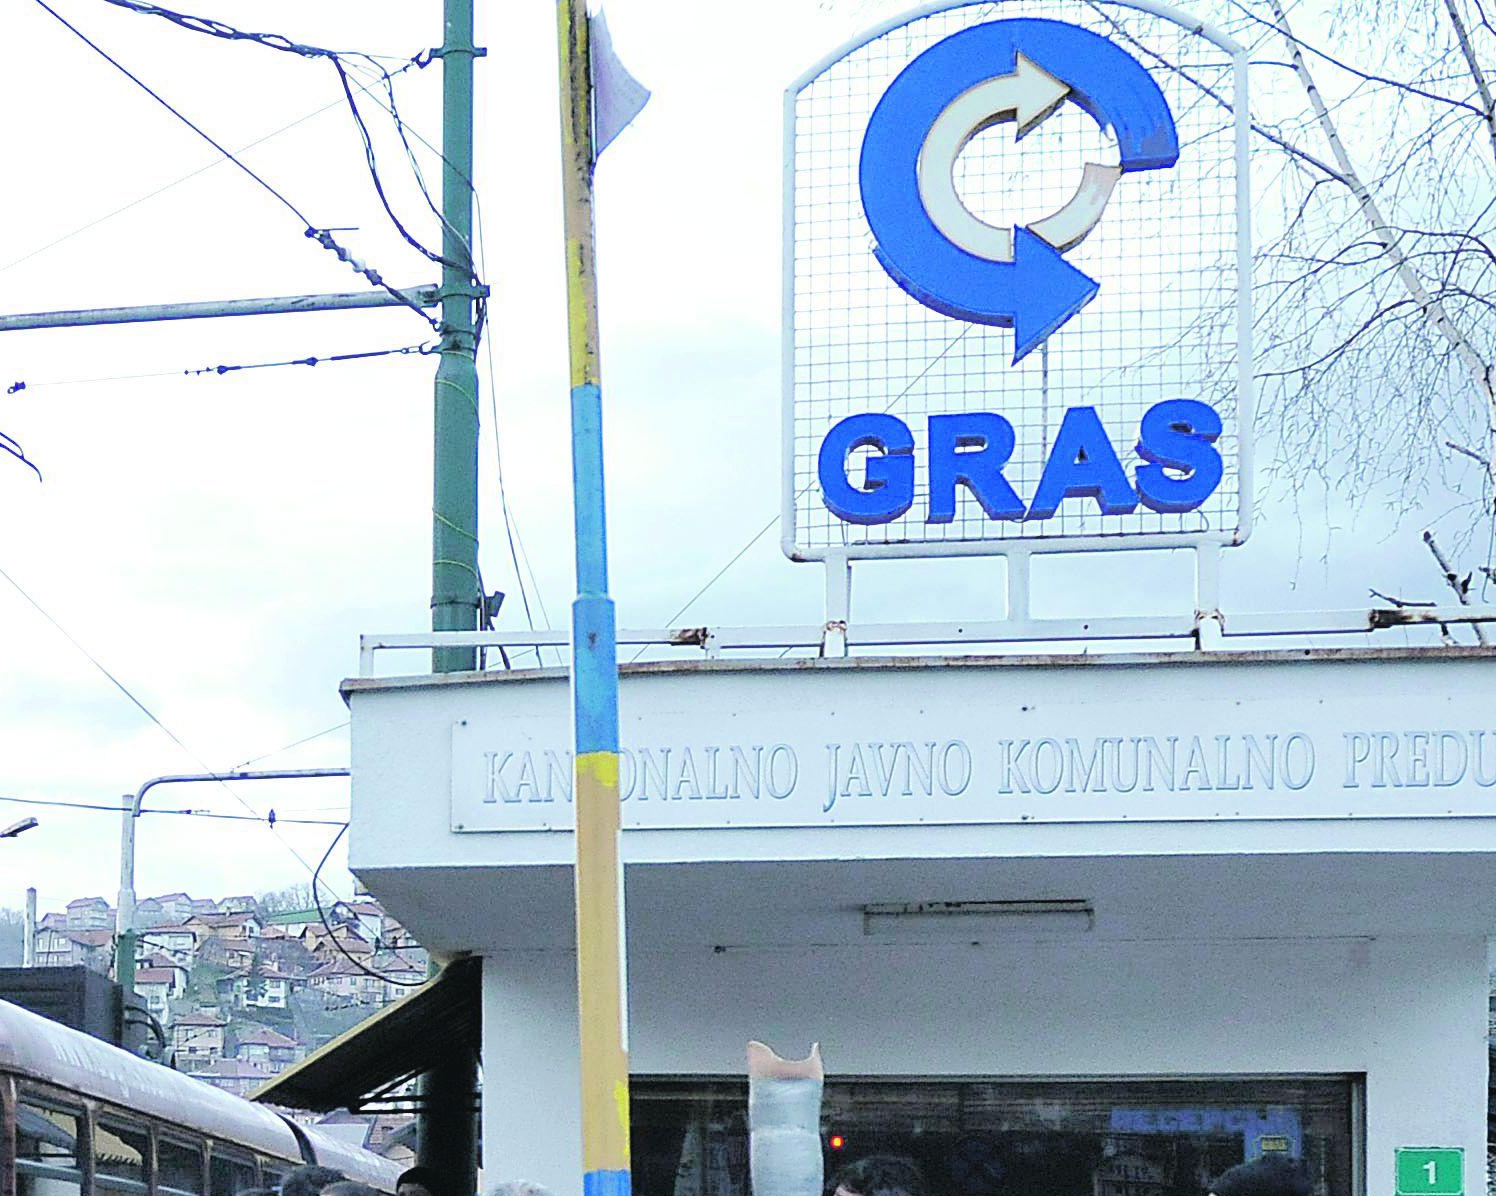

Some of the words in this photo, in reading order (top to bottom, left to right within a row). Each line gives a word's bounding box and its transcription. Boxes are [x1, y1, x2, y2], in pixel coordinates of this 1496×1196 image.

[817, 399, 1224, 525] GRAS
[483, 744, 799, 804] KANONALNO
[823, 738, 972, 812] JAVNO
[997, 730, 1316, 795] KOMUNALNO
[1422, 1160, 1437, 1185] 1
